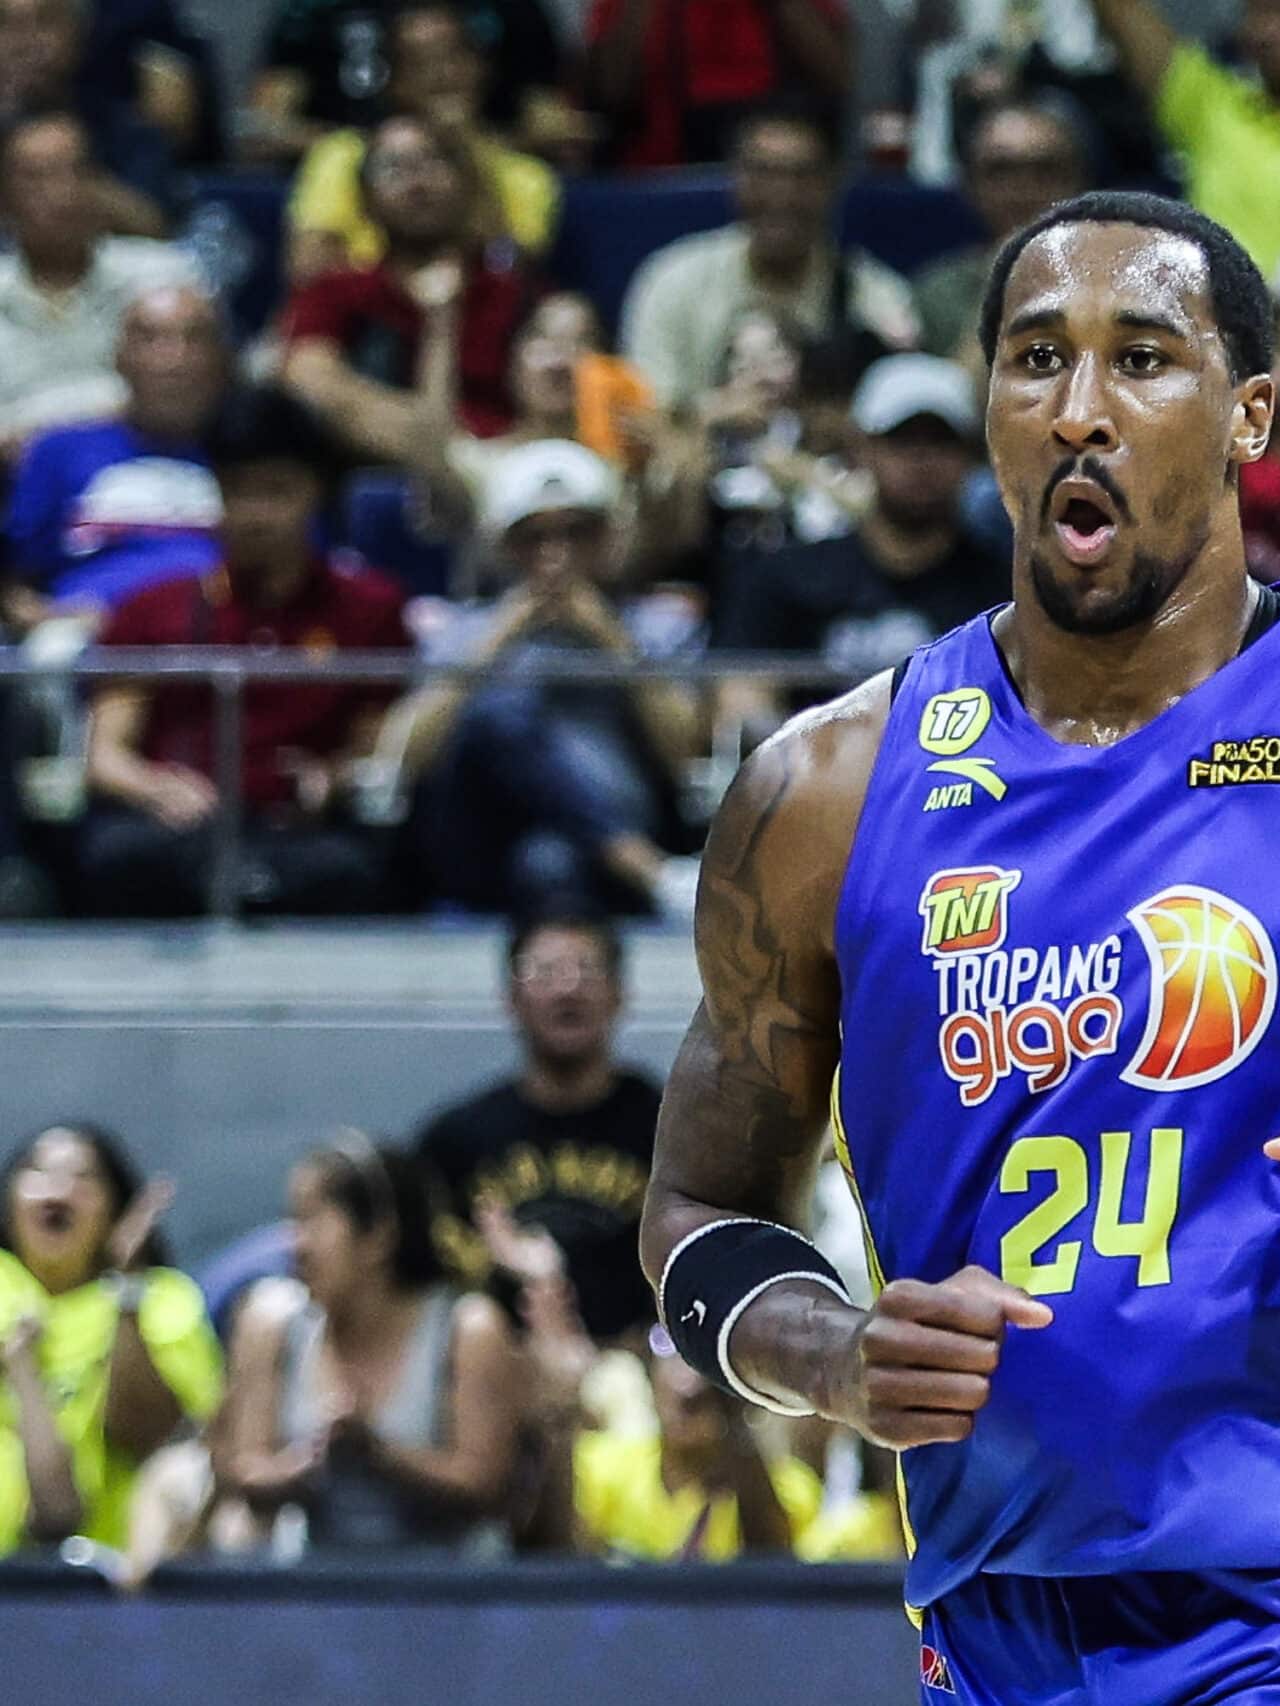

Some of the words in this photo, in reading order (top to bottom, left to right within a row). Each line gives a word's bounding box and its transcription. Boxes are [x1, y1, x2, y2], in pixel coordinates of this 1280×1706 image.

[928, 696, 981, 741] 17
[922, 782, 972, 812] ANTA
[924, 874, 1015, 947] TNT
[932, 935, 1121, 1016] TROPANG
[939, 992, 1122, 1107] giga
[1000, 1128, 1183, 1296] 24
